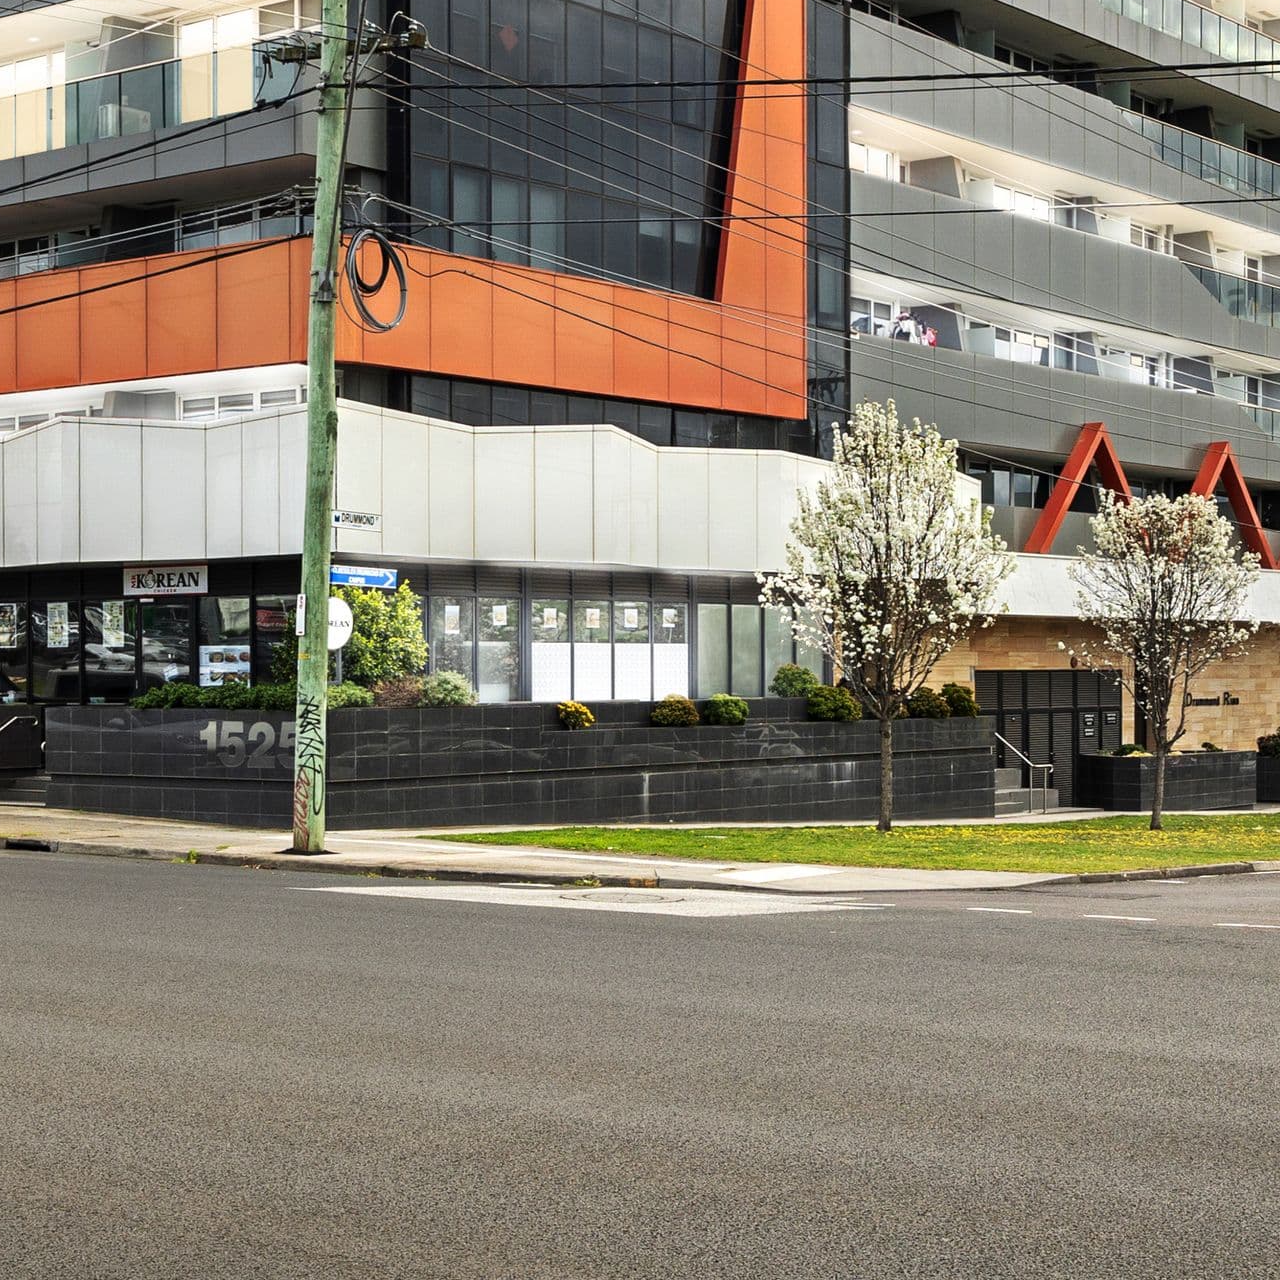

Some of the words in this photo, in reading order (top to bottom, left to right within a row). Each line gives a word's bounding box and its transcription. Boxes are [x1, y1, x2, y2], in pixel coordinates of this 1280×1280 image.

[341, 512, 375, 526] DRUMMOND
[136, 570, 200, 589] KOREAN
[199, 720, 296, 769] 1525
